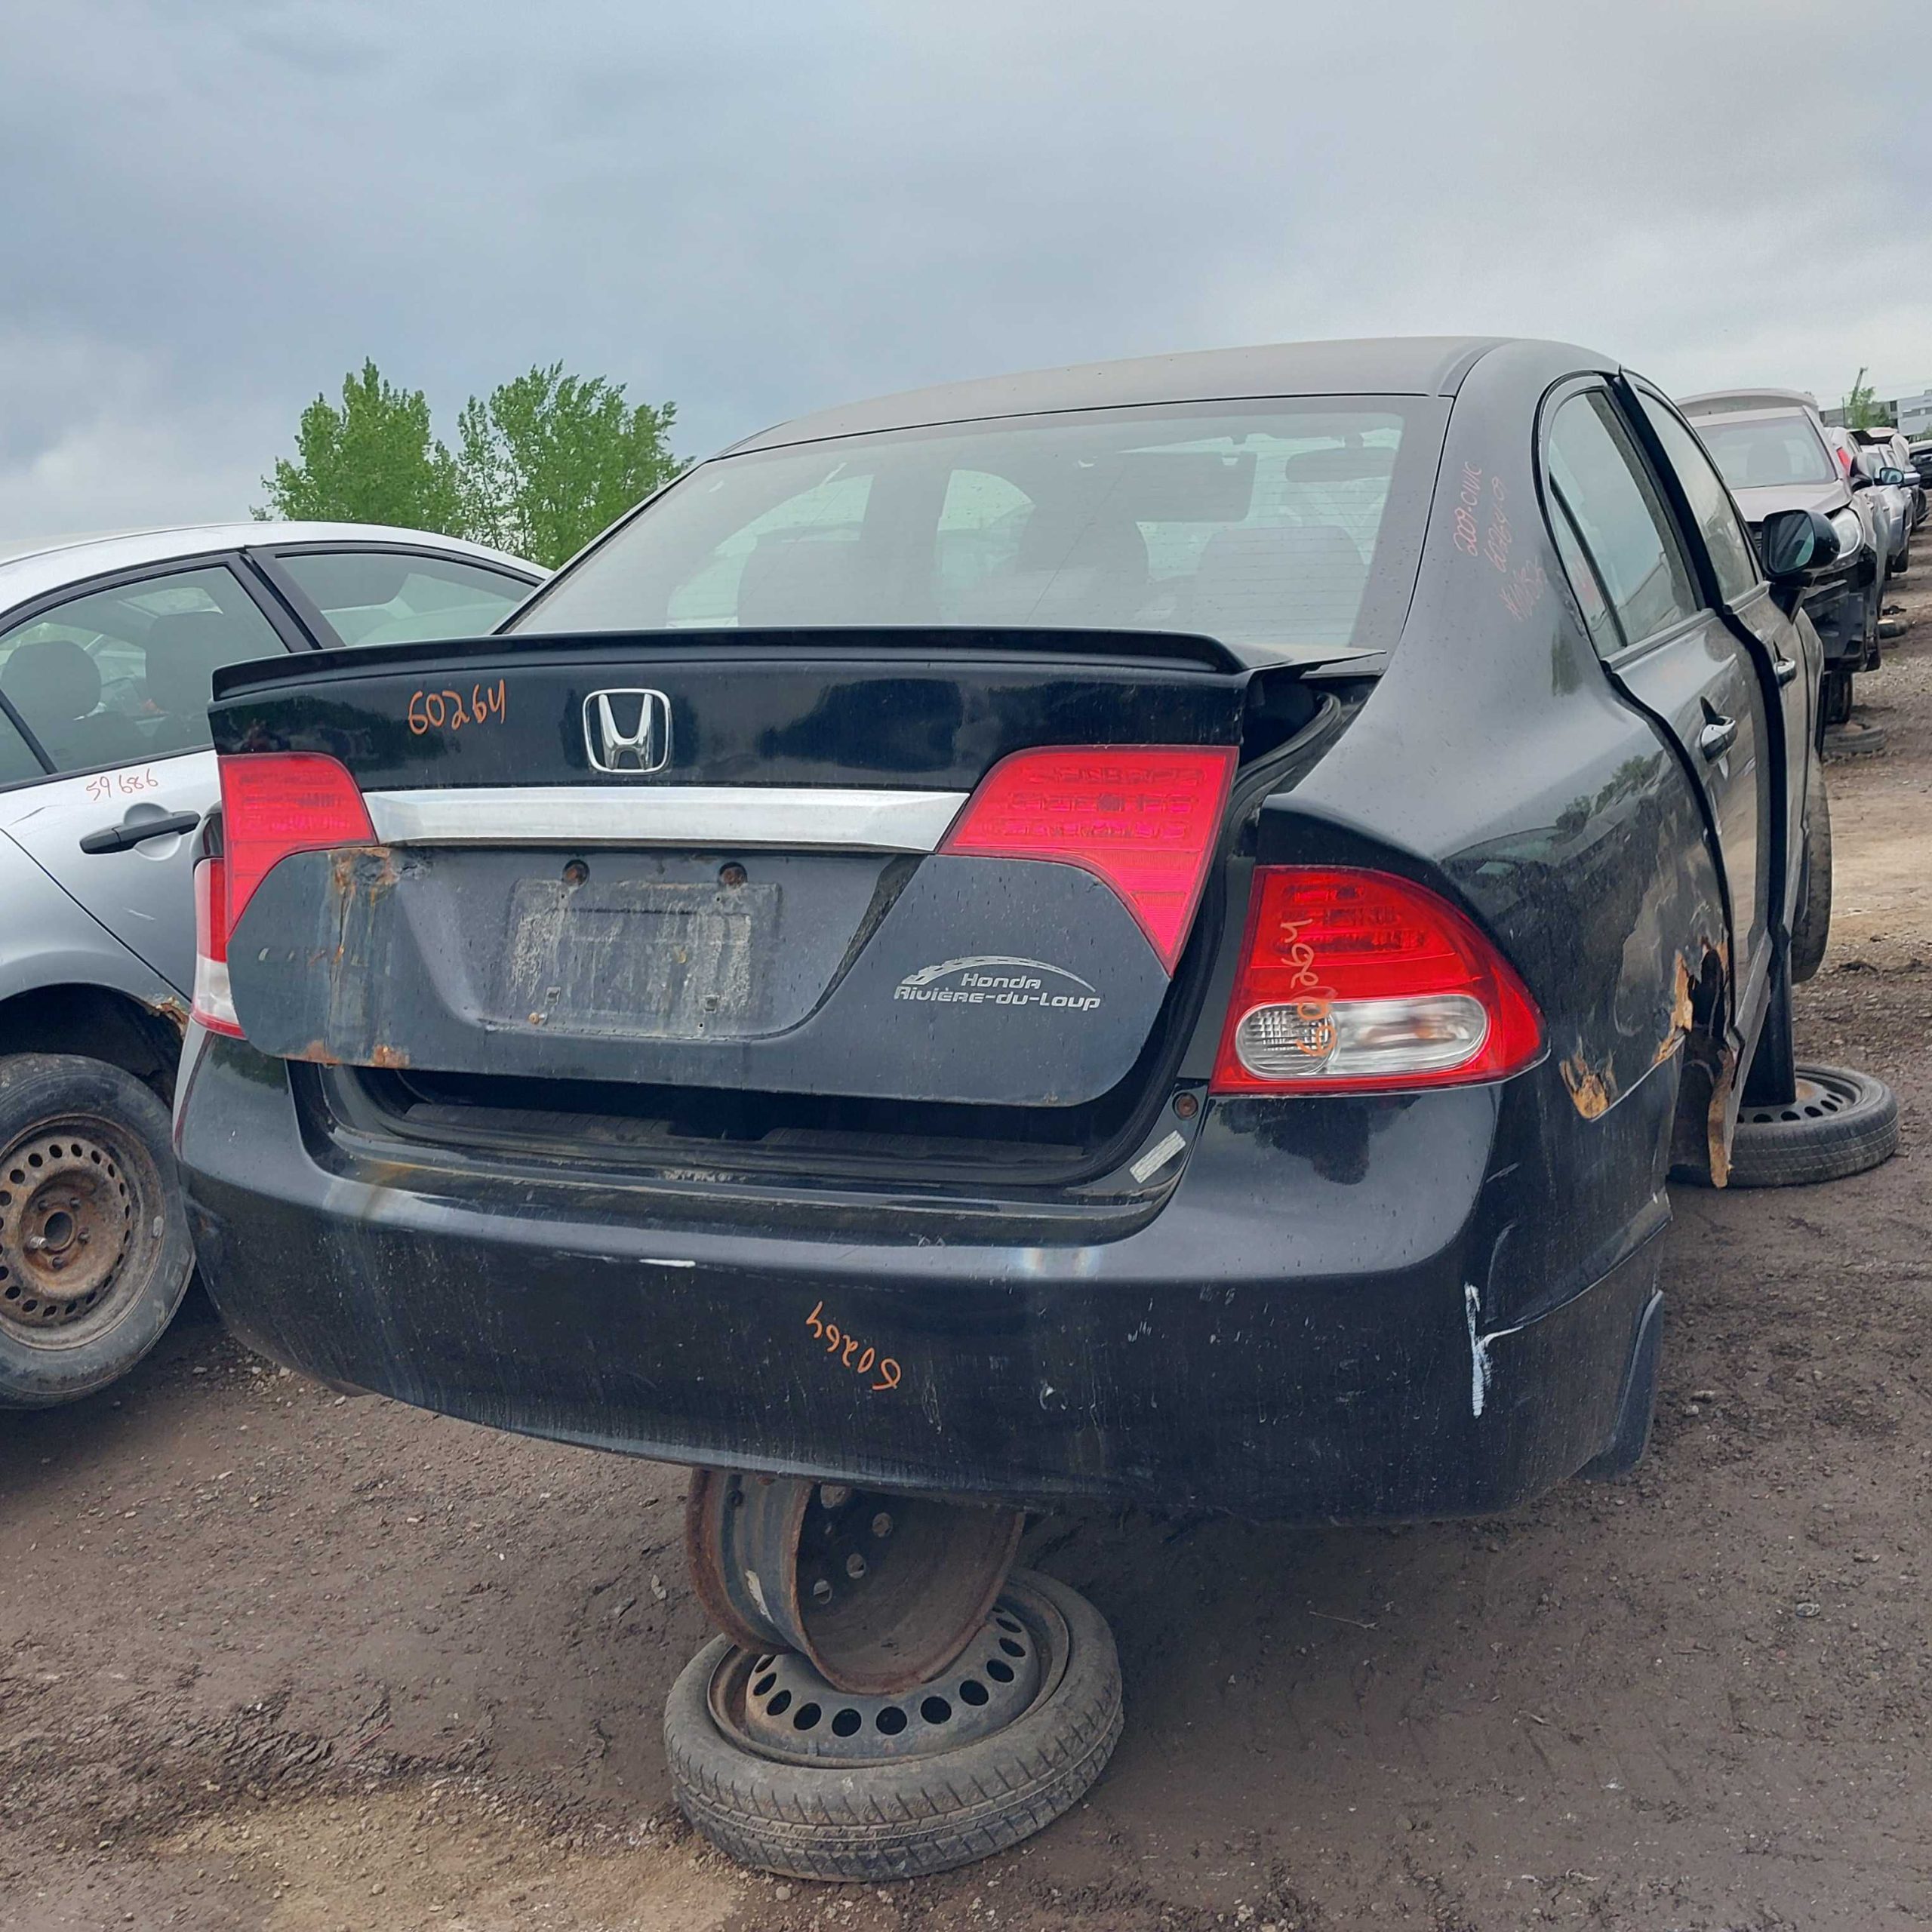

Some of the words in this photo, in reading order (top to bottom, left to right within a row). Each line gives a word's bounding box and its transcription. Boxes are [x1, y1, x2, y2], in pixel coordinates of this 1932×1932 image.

[408, 678, 506, 735] 60264
[960, 972, 1042, 989] Honda
[1280, 918, 1339, 1057] 60264
[805, 1300, 902, 1391] 60264
